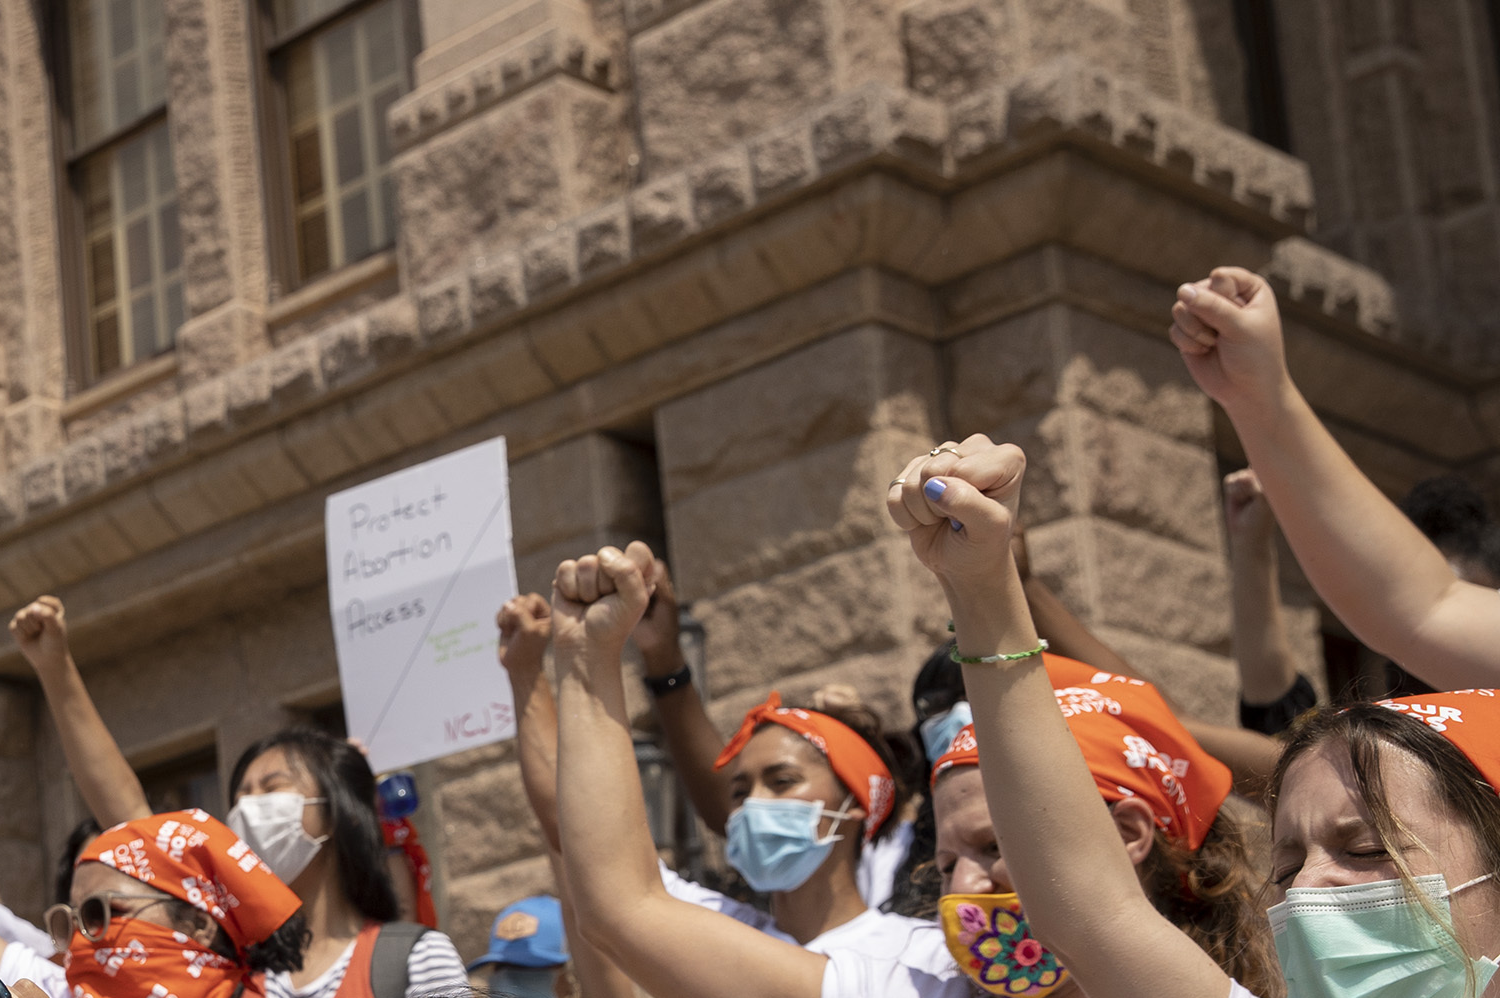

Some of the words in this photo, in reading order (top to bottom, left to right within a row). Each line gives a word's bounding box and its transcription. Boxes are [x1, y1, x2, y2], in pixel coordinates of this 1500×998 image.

[348, 484, 448, 538] Protect
[343, 531, 452, 582] Abortion
[345, 597, 427, 638] Access
